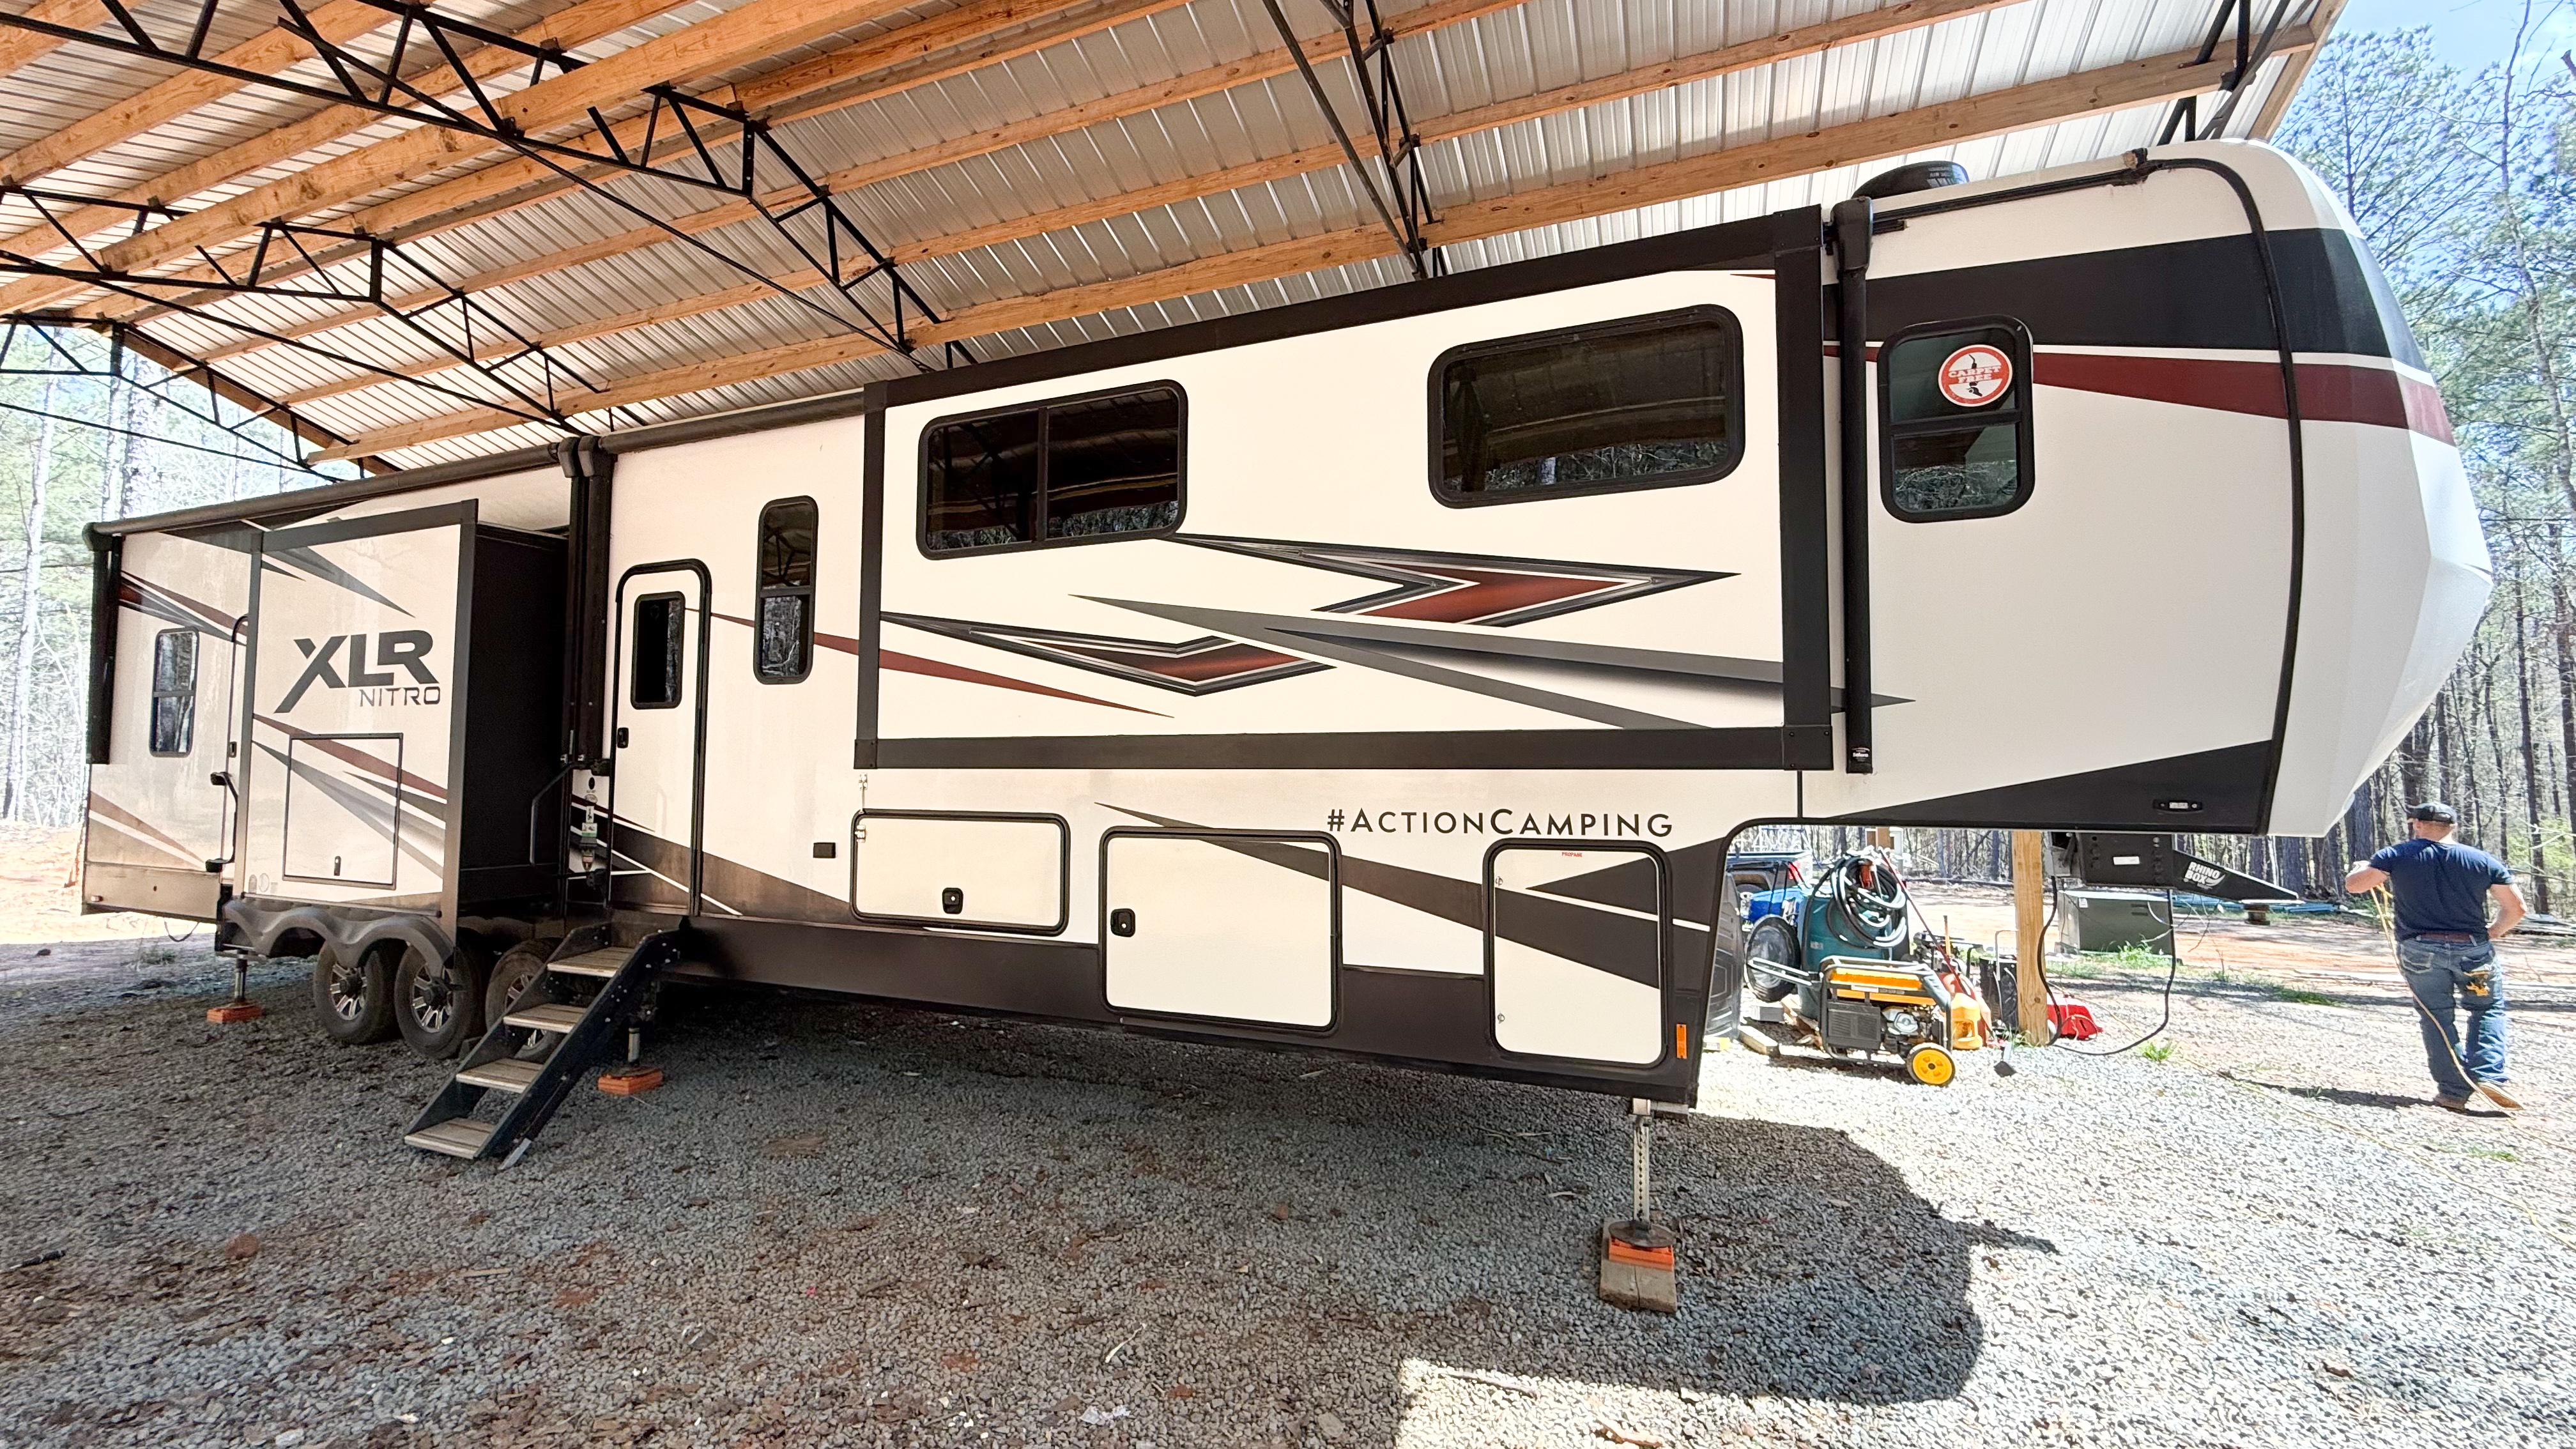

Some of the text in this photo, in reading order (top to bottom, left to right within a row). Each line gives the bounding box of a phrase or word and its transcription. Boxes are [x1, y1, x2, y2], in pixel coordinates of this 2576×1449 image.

[1948, 366, 2002, 378] CARPET
[1958, 373, 1993, 384] FREE
[273, 629, 440, 714] XLR
[359, 686, 441, 707] NITRO
[2184, 870, 2208, 884] BOX
[2188, 861, 2220, 879] RHINO
